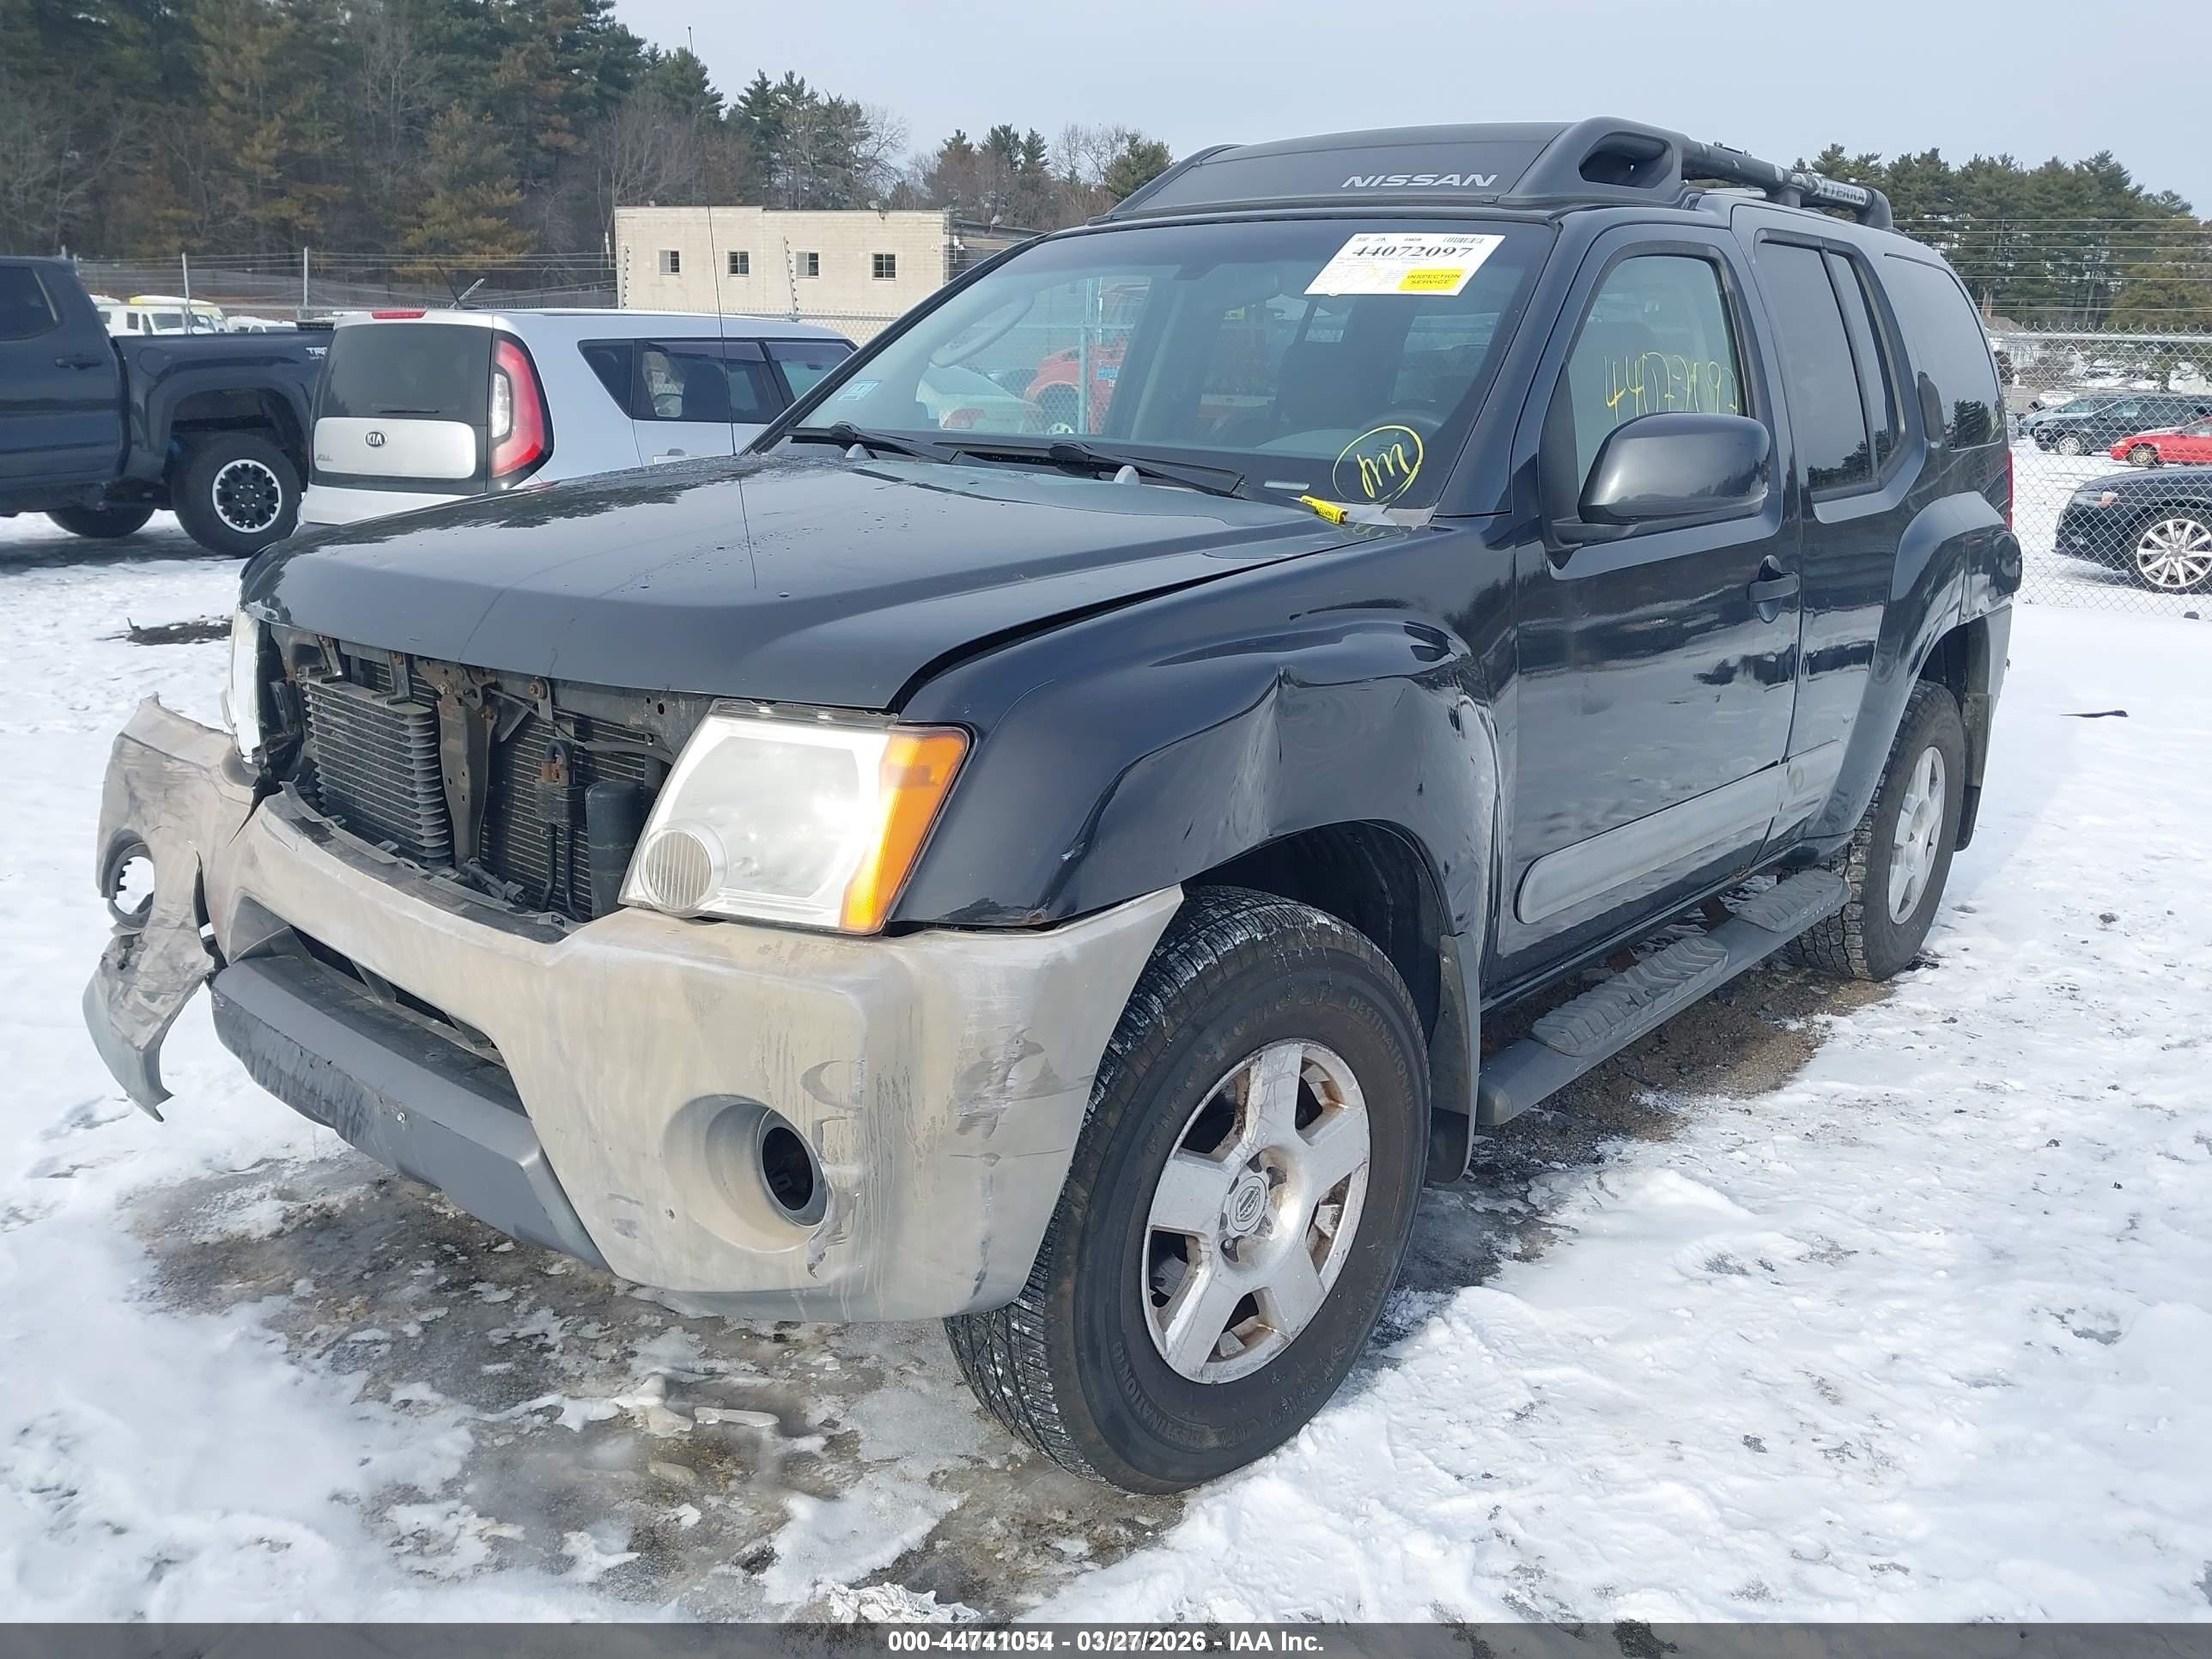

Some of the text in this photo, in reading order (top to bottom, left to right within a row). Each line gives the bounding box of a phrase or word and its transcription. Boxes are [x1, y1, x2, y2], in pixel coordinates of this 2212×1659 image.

[1340, 173, 1498, 188] NISSAN
[1352, 245, 1474, 259] 44072097
[367, 433, 383, 446] KIA
[1346, 994, 1407, 1091] DESTINATION
